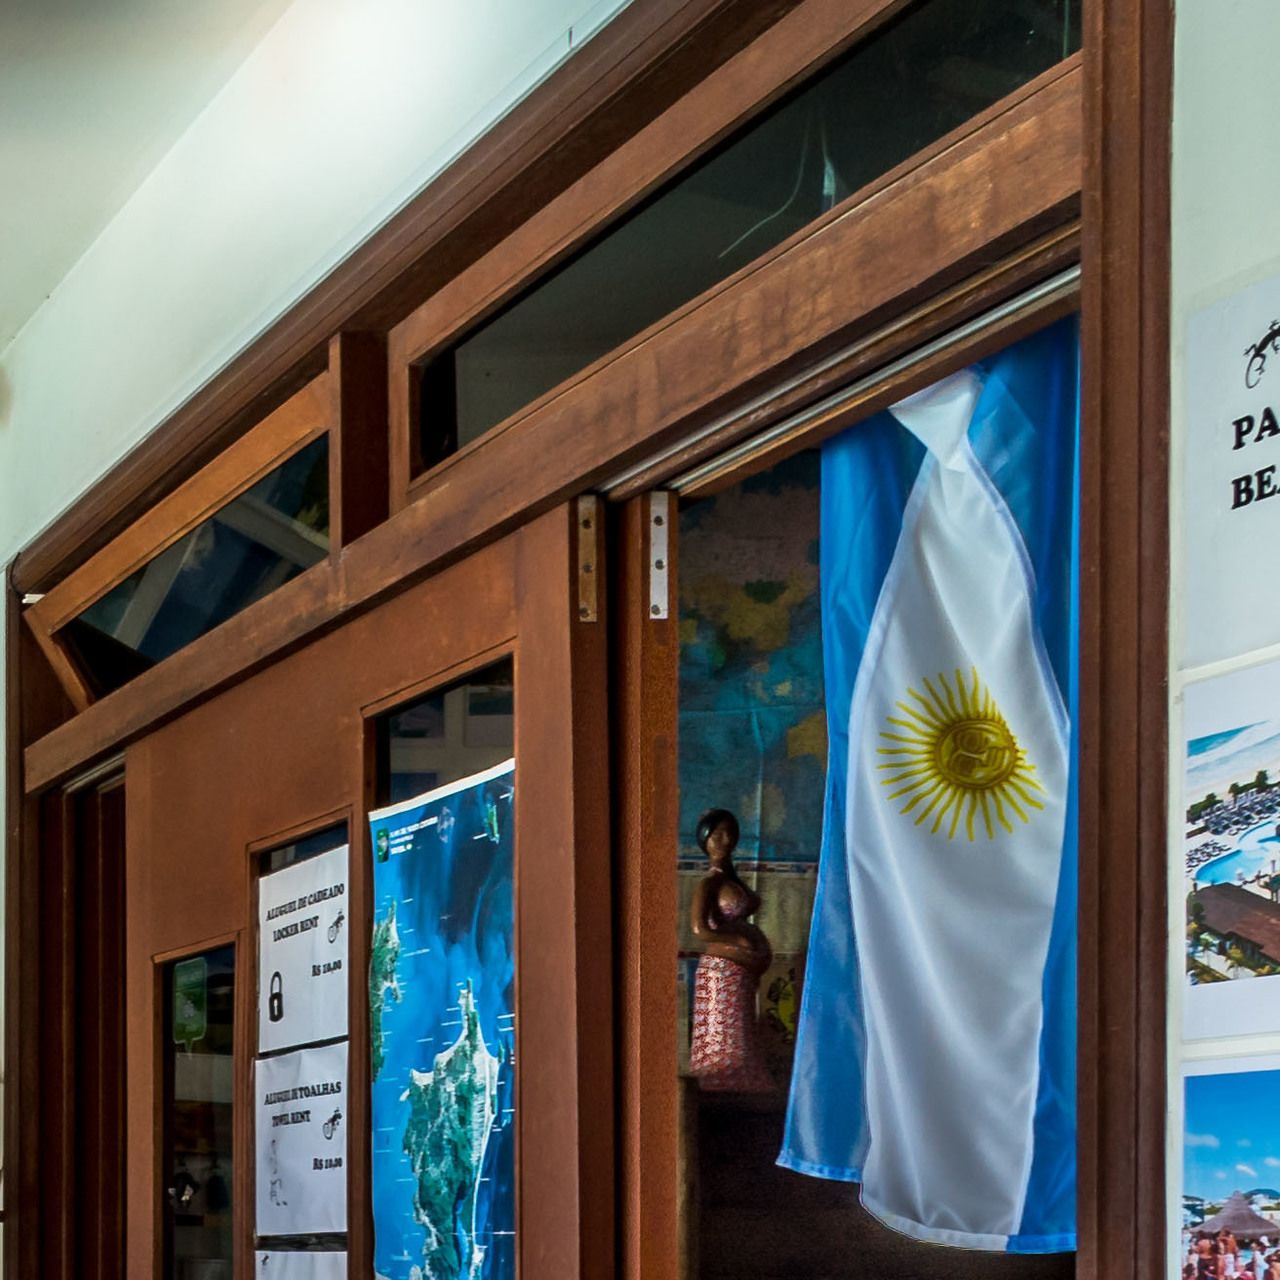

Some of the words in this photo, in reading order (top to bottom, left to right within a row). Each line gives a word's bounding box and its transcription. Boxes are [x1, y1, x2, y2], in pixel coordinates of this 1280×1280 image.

[1231, 465, 1280, 510] BE
[308, 883, 344, 905] CADEADO
[273, 922, 299, 942] LOCKER
[300, 915, 319, 933] RENT
[299, 1081, 342, 1099] TOALHAS
[290, 1110, 311, 1124] RENT
[313, 1158, 323, 1171] R$
